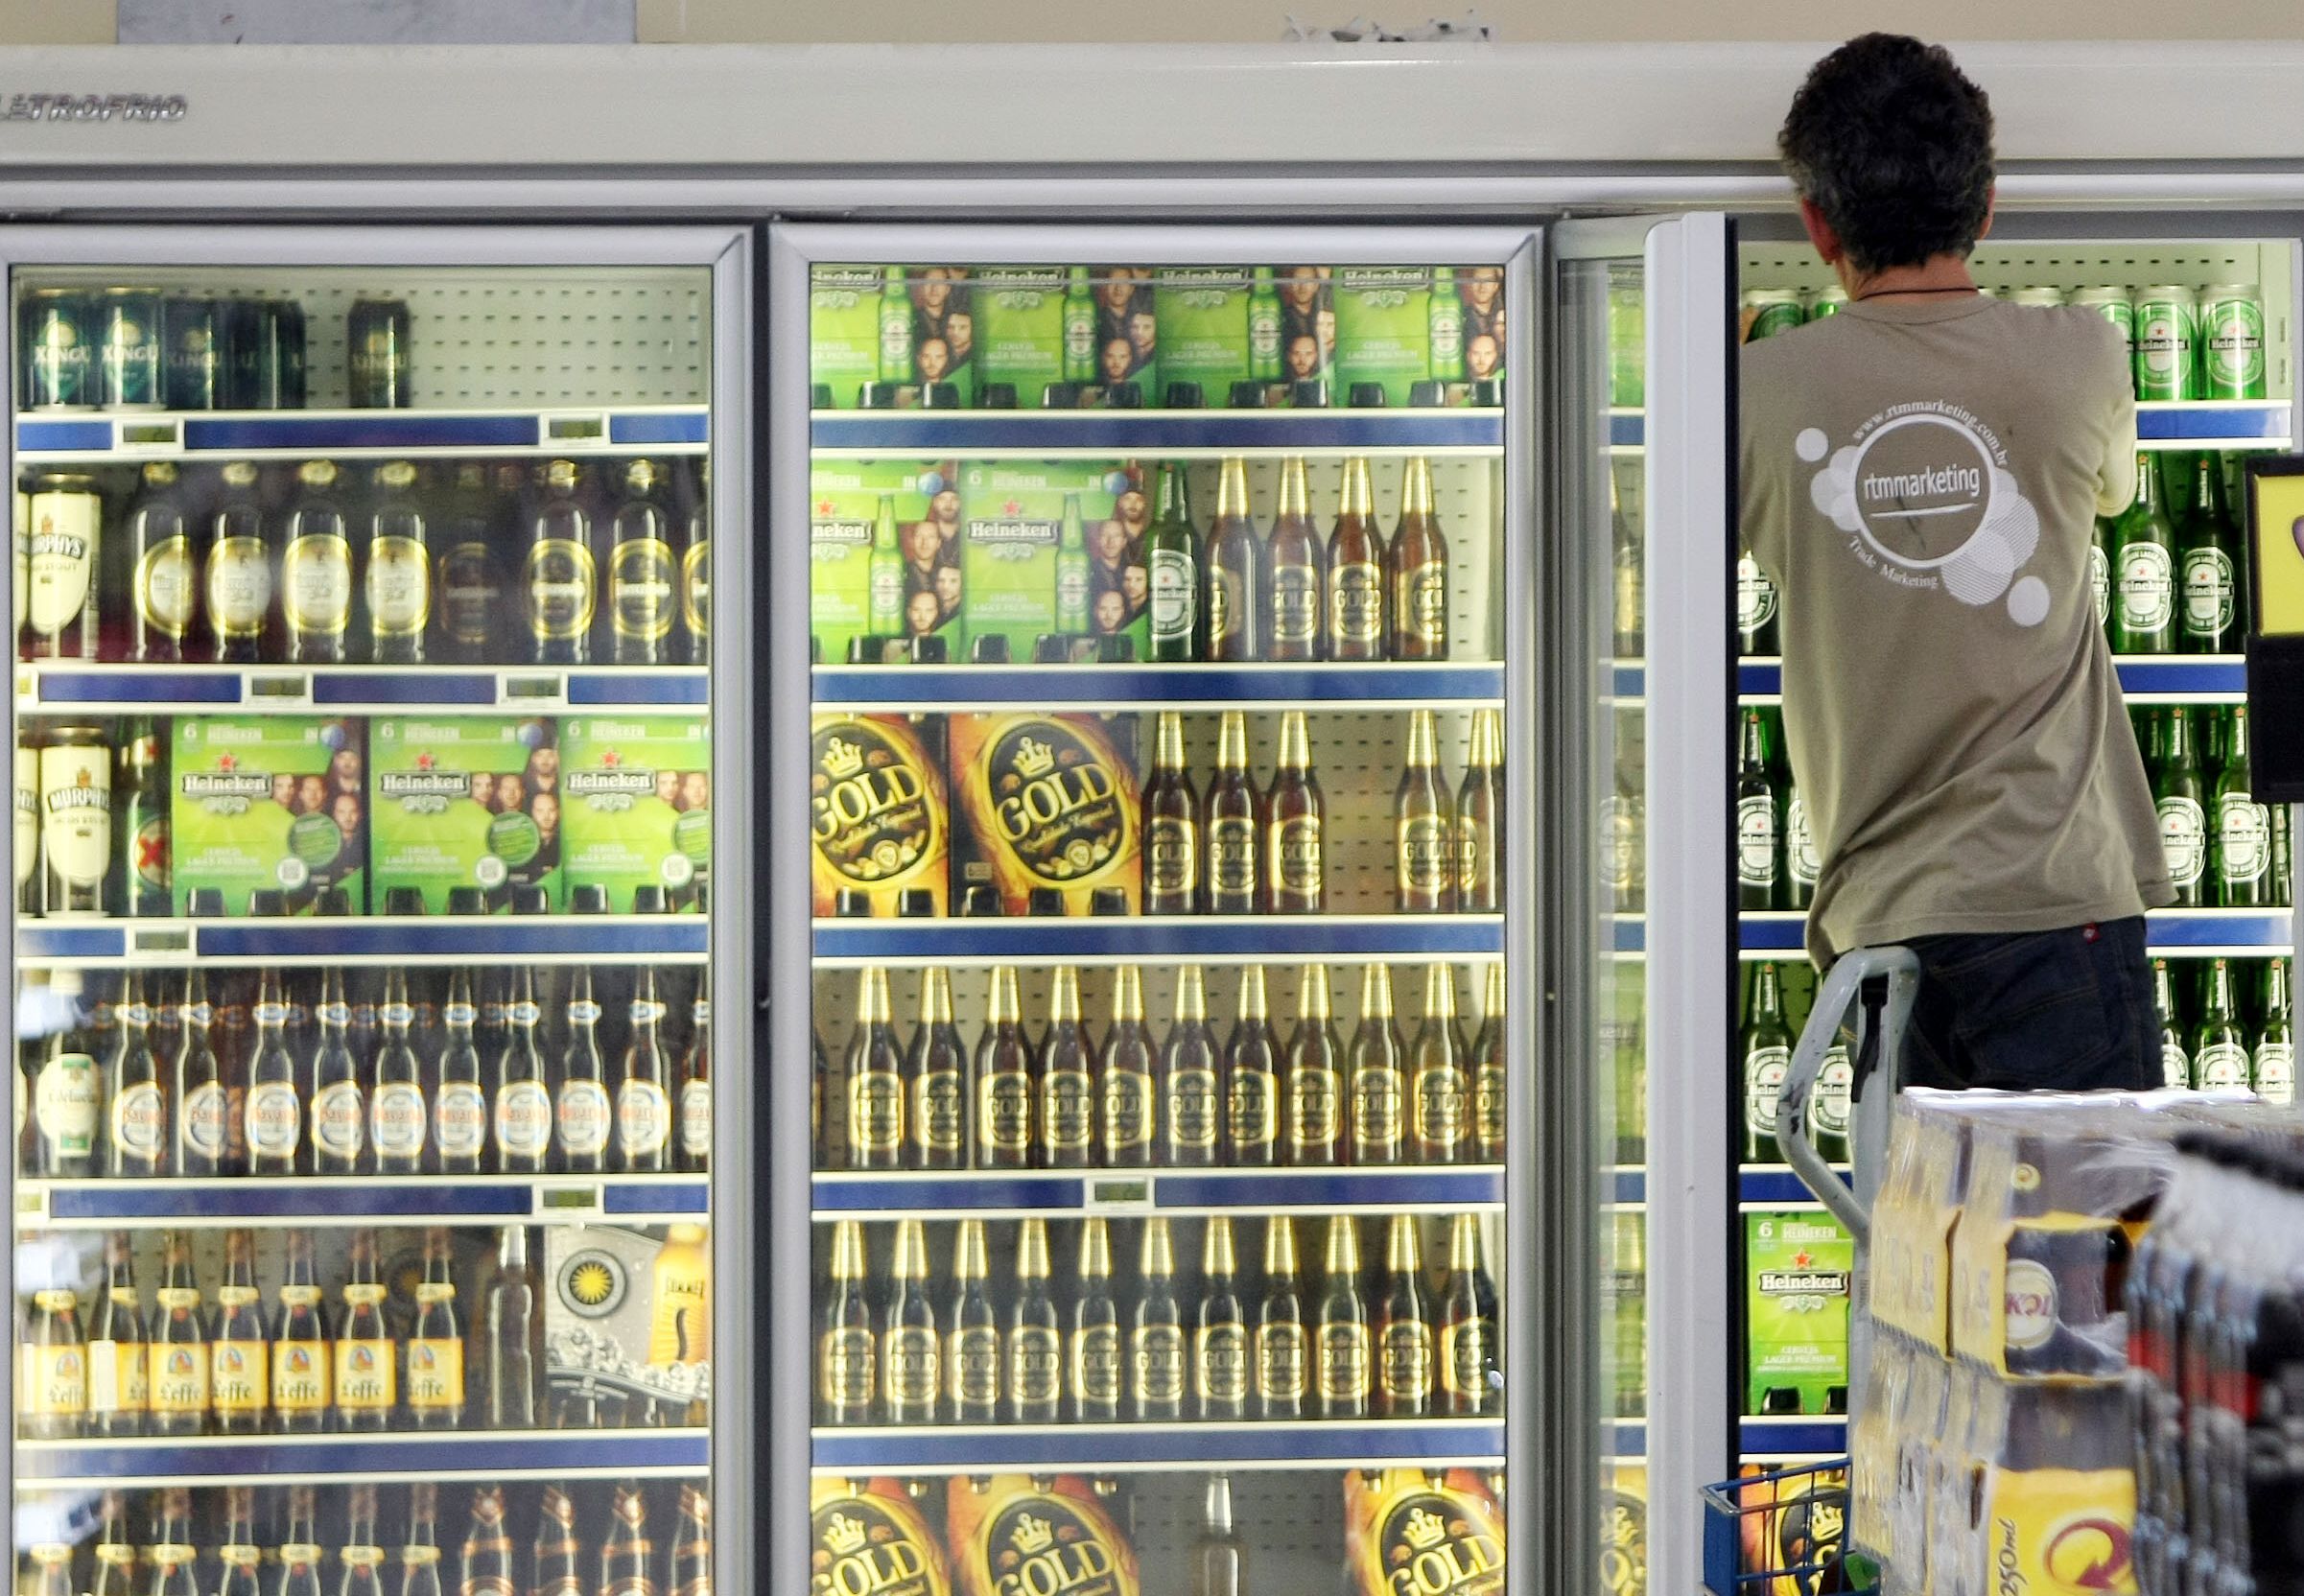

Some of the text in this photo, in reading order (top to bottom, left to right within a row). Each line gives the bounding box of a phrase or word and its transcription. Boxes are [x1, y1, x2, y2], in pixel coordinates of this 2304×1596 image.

[2211, 339, 2259, 349] Heinken
[35, 345, 91, 364] XNGU
[103, 345, 158, 363] XNGU
[1852, 399, 2008, 466] www.rtmmarketing.com.br
[1865, 463, 1980, 500] rtmmarketing
[971, 522, 1052, 537] Heineken
[1879, 564, 1938, 590] Marketing
[184, 774, 268, 791] Heineken
[384, 772, 465, 790] Heineken
[570, 771, 650, 788] Heineken
[997, 764, 1116, 842] GOLD
[1759, 1222, 1774, 1237] 6
[1761, 1274, 1843, 1290] Heineken
[412, 1379, 445, 1399] effe
